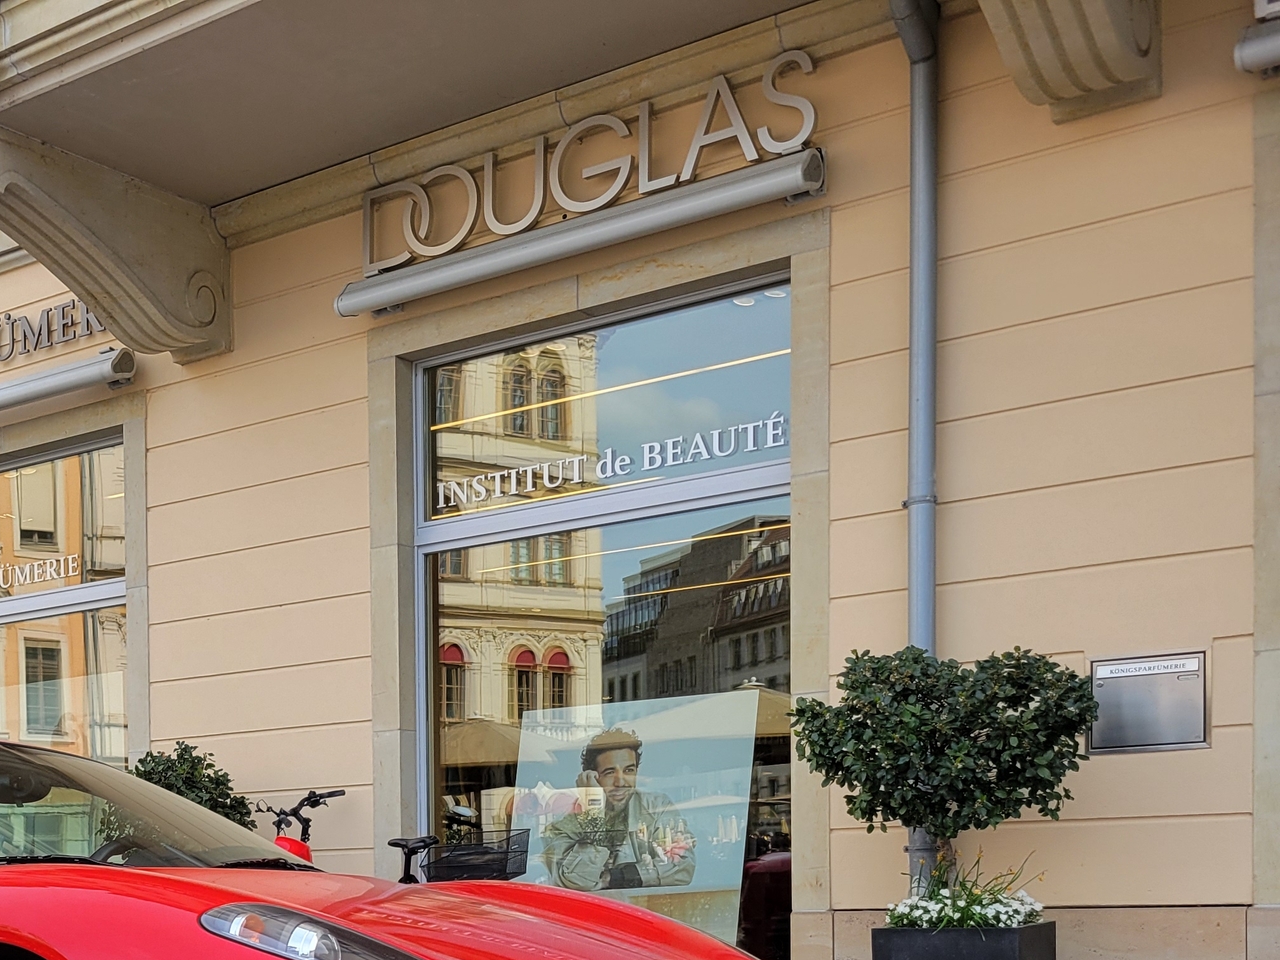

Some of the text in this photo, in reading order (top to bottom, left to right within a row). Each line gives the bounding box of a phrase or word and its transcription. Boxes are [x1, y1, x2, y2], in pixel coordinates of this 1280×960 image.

[362, 49, 816, 278] DOUGLAS
[436, 410, 786, 509] INSTITUT de BEAUTÉ
[1109, 662, 1187, 675] KÖNIGSPARFÜMERIE
